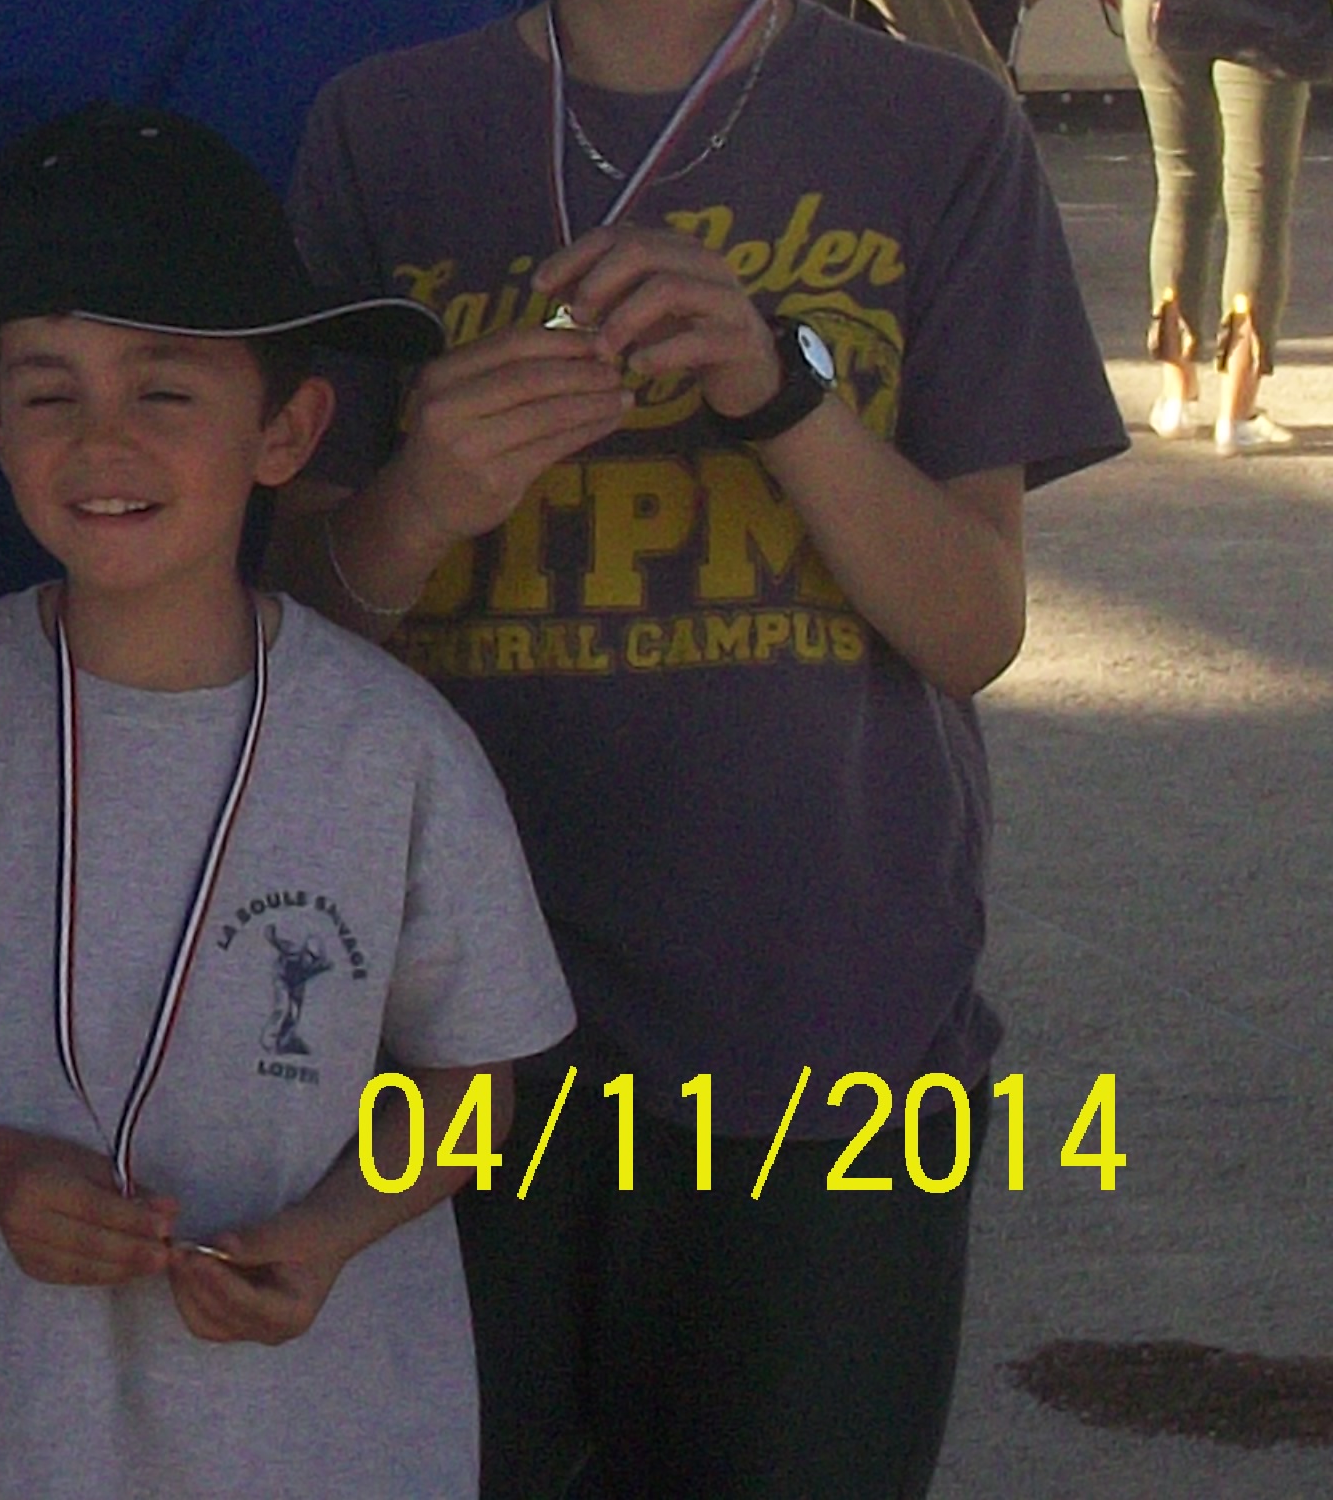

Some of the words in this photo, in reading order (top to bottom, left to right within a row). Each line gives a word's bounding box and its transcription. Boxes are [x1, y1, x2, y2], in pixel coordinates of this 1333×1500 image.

[624, 609, 866, 672] CAMPUS
[217, 924, 237, 952] LA
[237, 890, 308, 925] BOULE
